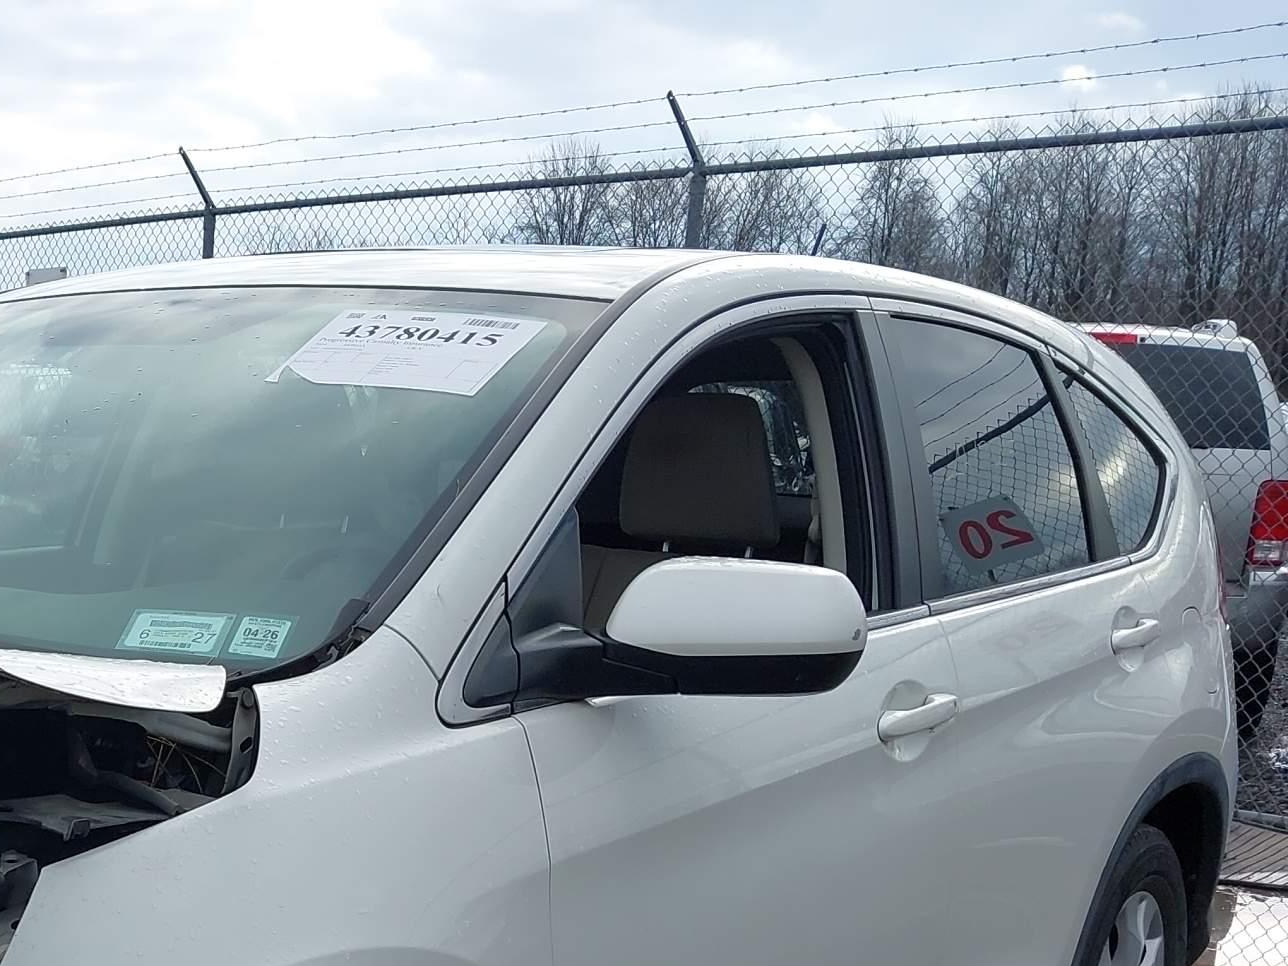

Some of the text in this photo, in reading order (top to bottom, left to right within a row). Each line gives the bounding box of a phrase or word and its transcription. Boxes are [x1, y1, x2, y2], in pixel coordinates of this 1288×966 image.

[339, 323, 504, 347] 43780415
[139, 629, 151, 639] 6
[192, 632, 216, 644] 27
